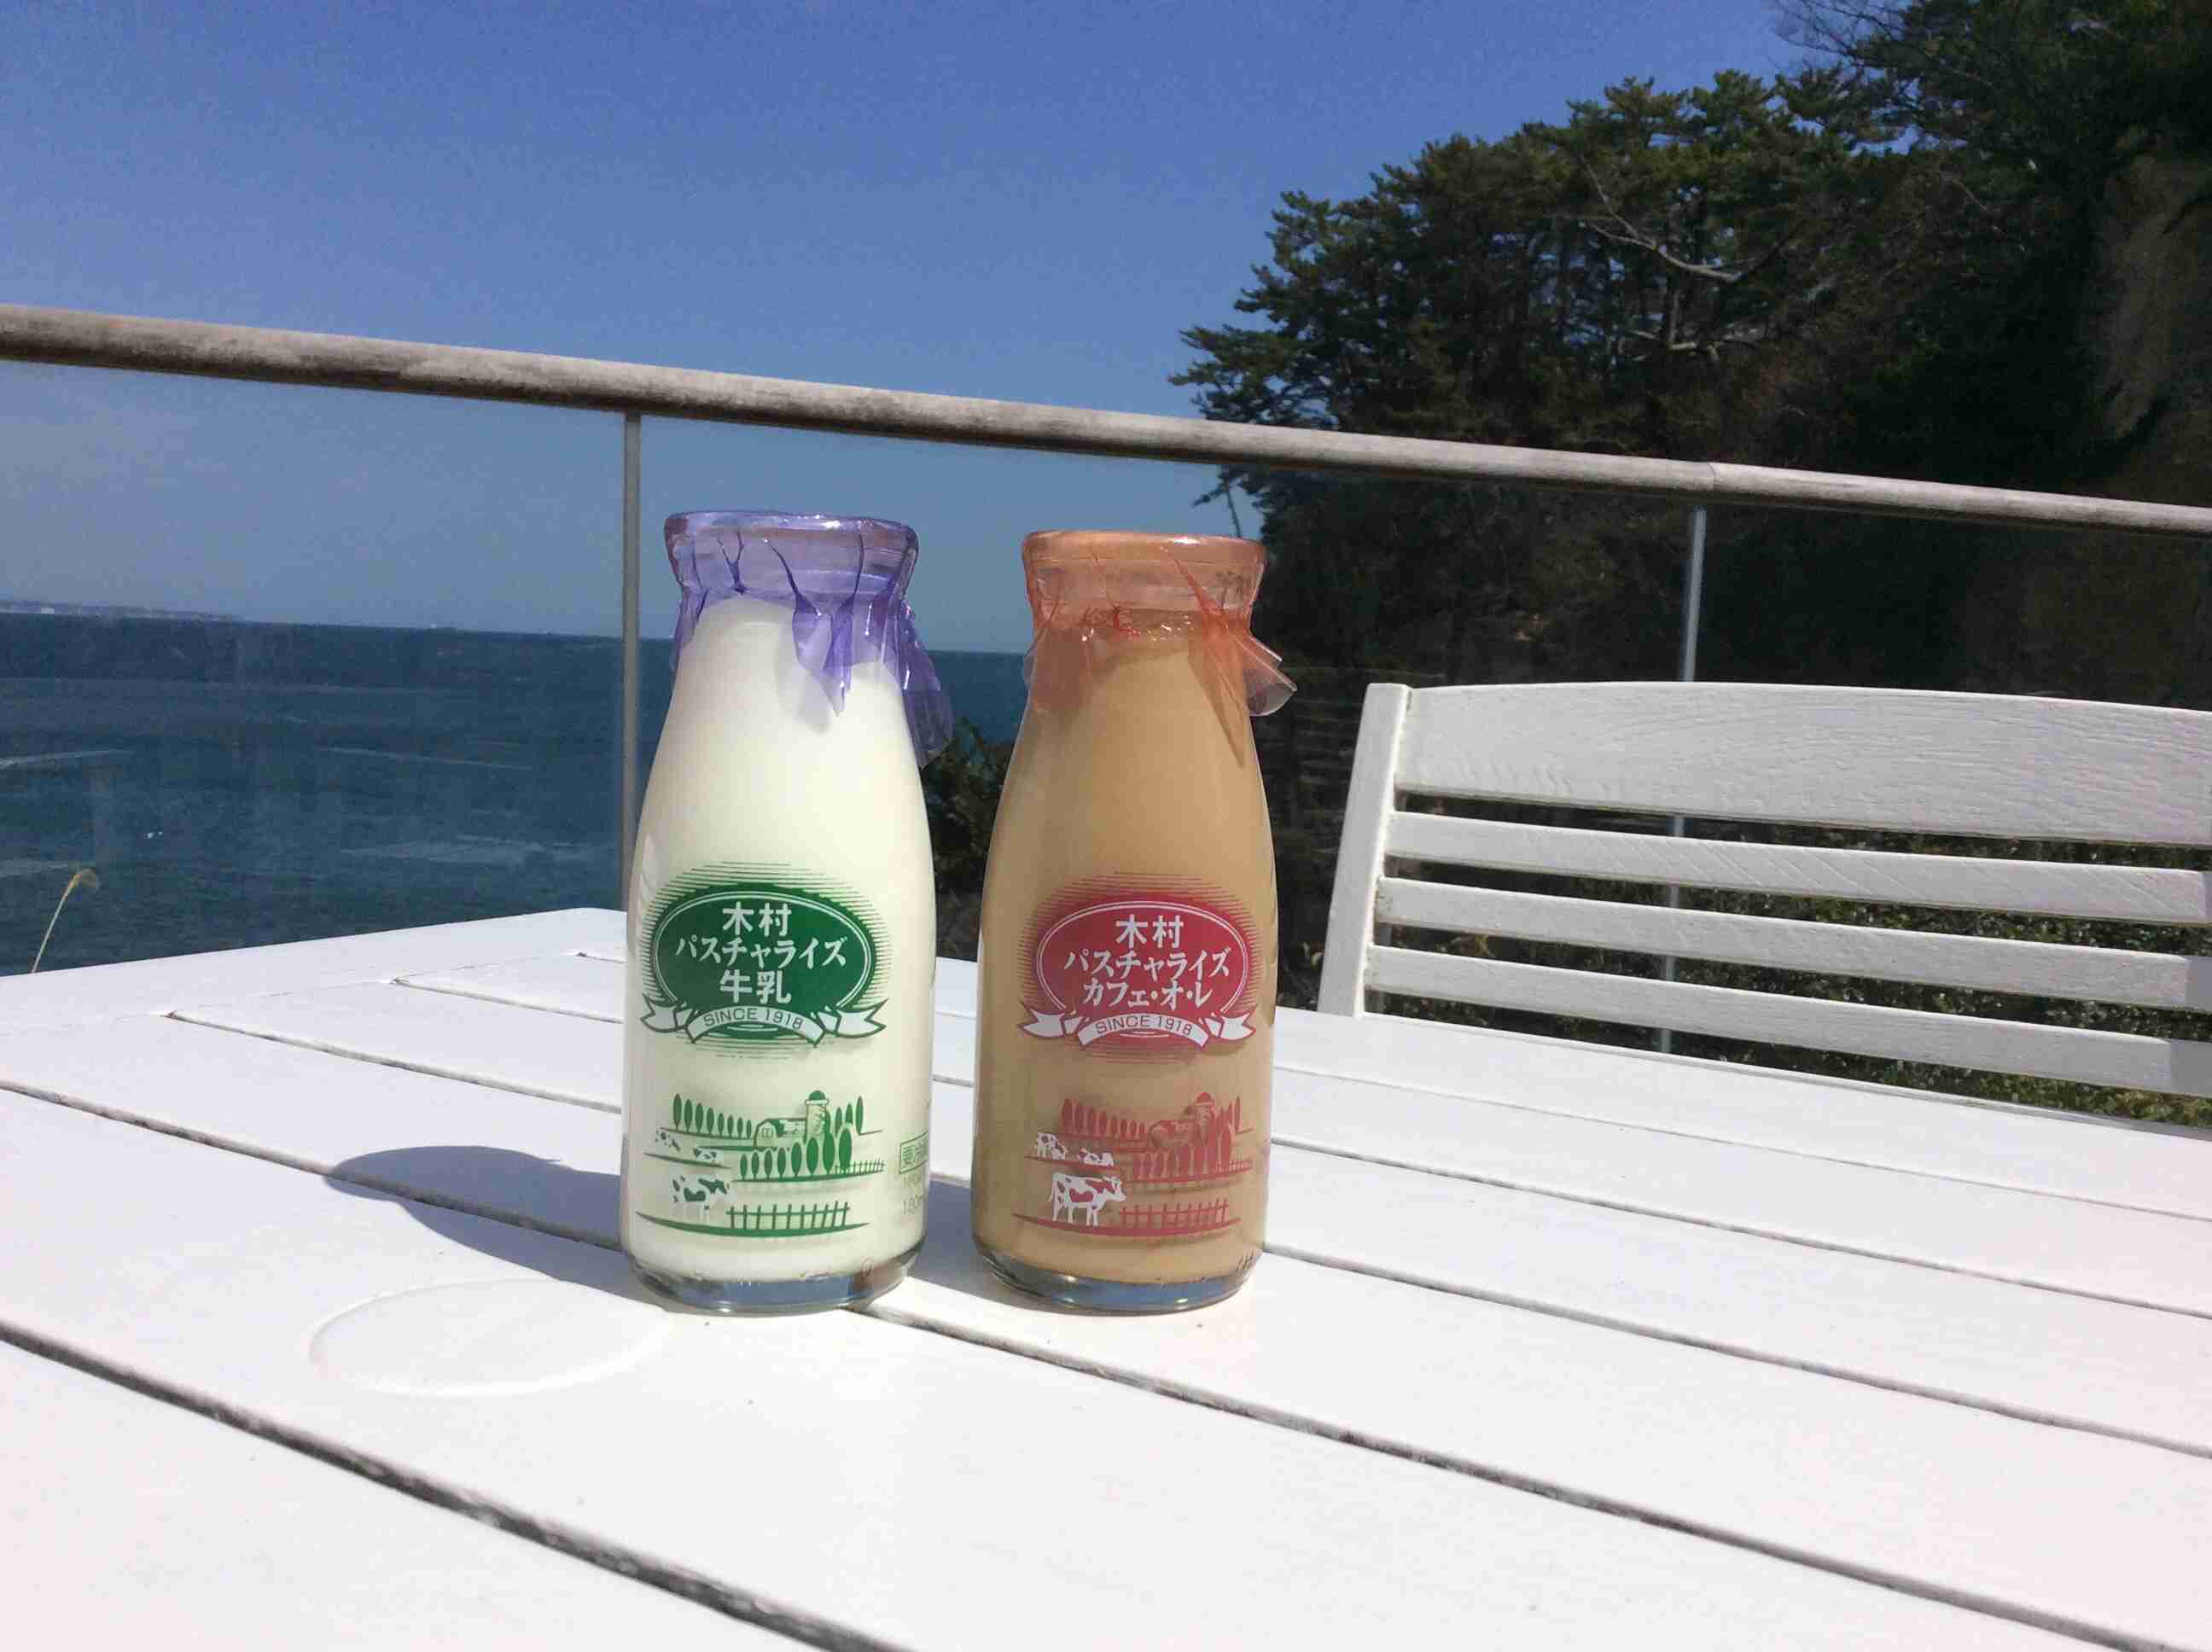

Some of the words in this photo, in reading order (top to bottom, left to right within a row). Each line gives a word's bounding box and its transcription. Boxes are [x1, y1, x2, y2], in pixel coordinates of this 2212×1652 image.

[722, 901, 793, 936] 木村
[1115, 913, 1185, 948] 木村
[675, 935, 848, 969] パスチャライズ
[1063, 947, 1231, 981] パスチャライズ
[719, 969, 792, 1004] 牛乳
[704, 1008, 759, 1028] SINCE
[765, 1008, 804, 1029] 1918
[1096, 1015, 1150, 1036] SINCE
[1159, 1015, 1194, 1036] 1918
